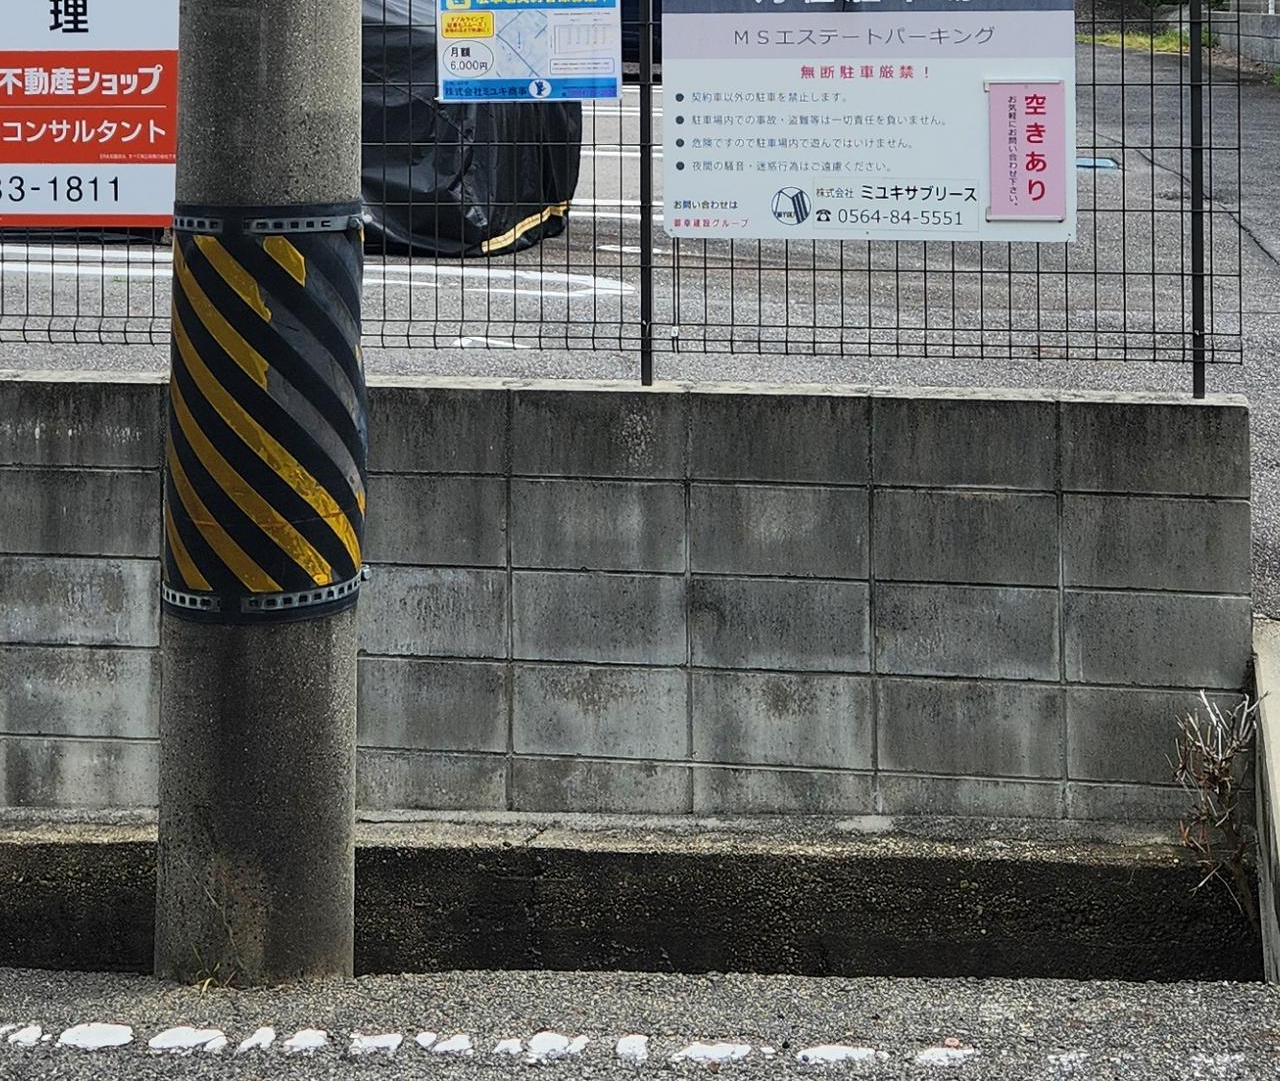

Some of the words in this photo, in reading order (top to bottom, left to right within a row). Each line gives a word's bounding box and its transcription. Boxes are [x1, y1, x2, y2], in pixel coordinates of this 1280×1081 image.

[734, 26, 995, 45] MSエステートパーキング
[1024, 93, 1047, 202] 空きあり
[816, 188, 853, 199] 株式会社
[861, 185, 977, 202] ミユキサブリース
[673, 200, 738, 210] お問い合わせは
[838, 208, 963, 226] 0564-84-5551
